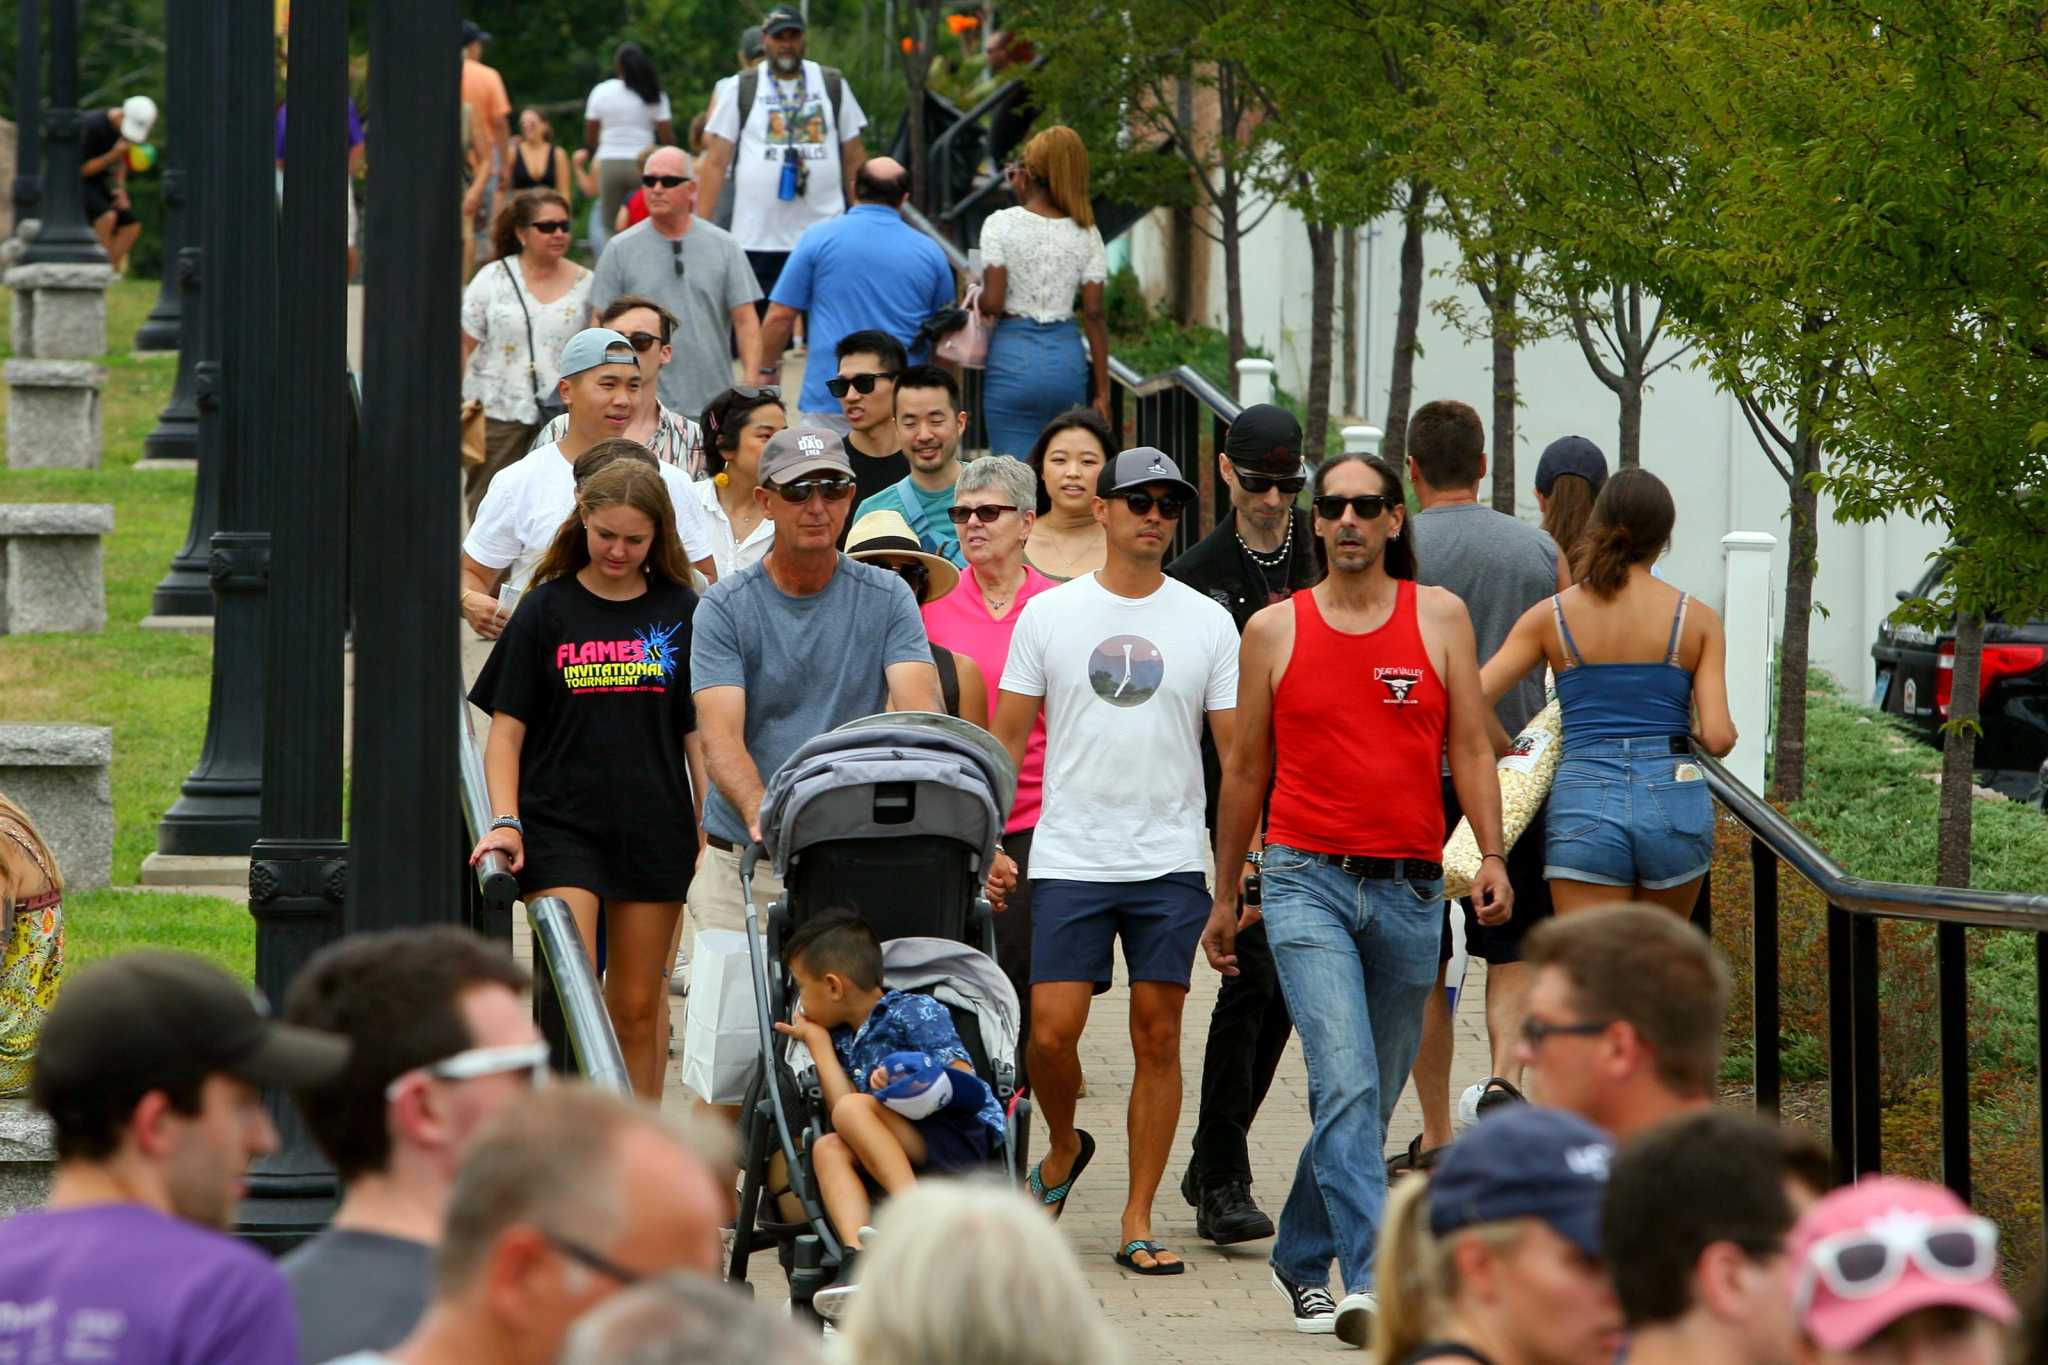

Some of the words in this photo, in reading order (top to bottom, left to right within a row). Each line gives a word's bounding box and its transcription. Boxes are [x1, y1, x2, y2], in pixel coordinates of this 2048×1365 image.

[798, 439, 824, 450] DAD
[557, 640, 645, 669] FLAMES
[564, 663, 664, 679] INVITATIONAL
[1374, 667, 1399, 680] DEATH
[1399, 667, 1424, 682] VALLEY
[565, 675, 641, 689] TOURNAMENT
